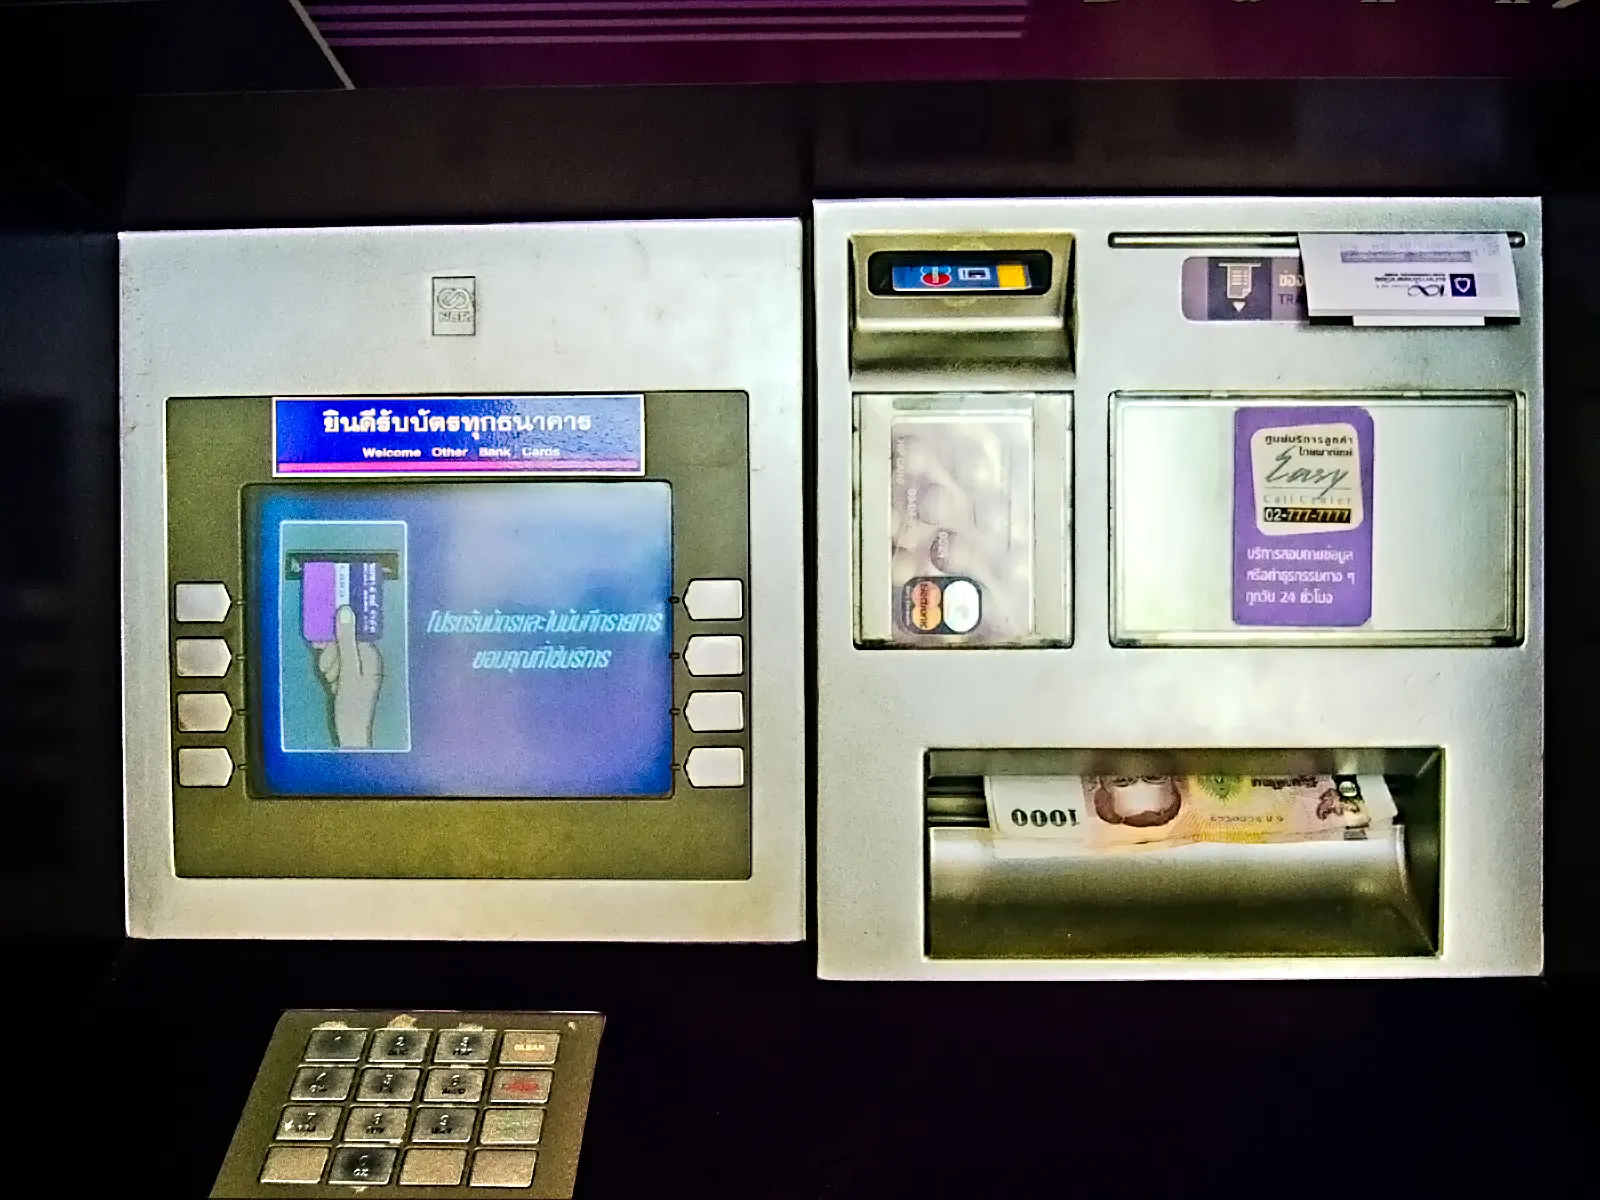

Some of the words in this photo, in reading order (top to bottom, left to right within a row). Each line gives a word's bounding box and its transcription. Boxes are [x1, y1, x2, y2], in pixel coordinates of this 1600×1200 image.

[322, 408, 592, 440] ยินดีรับบัตรทุกธนาคาร
[362, 446, 422, 459] Welcome
[431, 446, 469, 459] Other
[478, 446, 512, 459] Bank
[521, 446, 561, 459] Cards
[1265, 445, 1350, 500] Easy
[1263, 494, 1294, 505] Call
[1299, 494, 1353, 506] Center
[1264, 507, 1350, 522] 02-777-7777
[1280, 592, 1296, 604] 24
[1010, 808, 1080, 828] 1000
